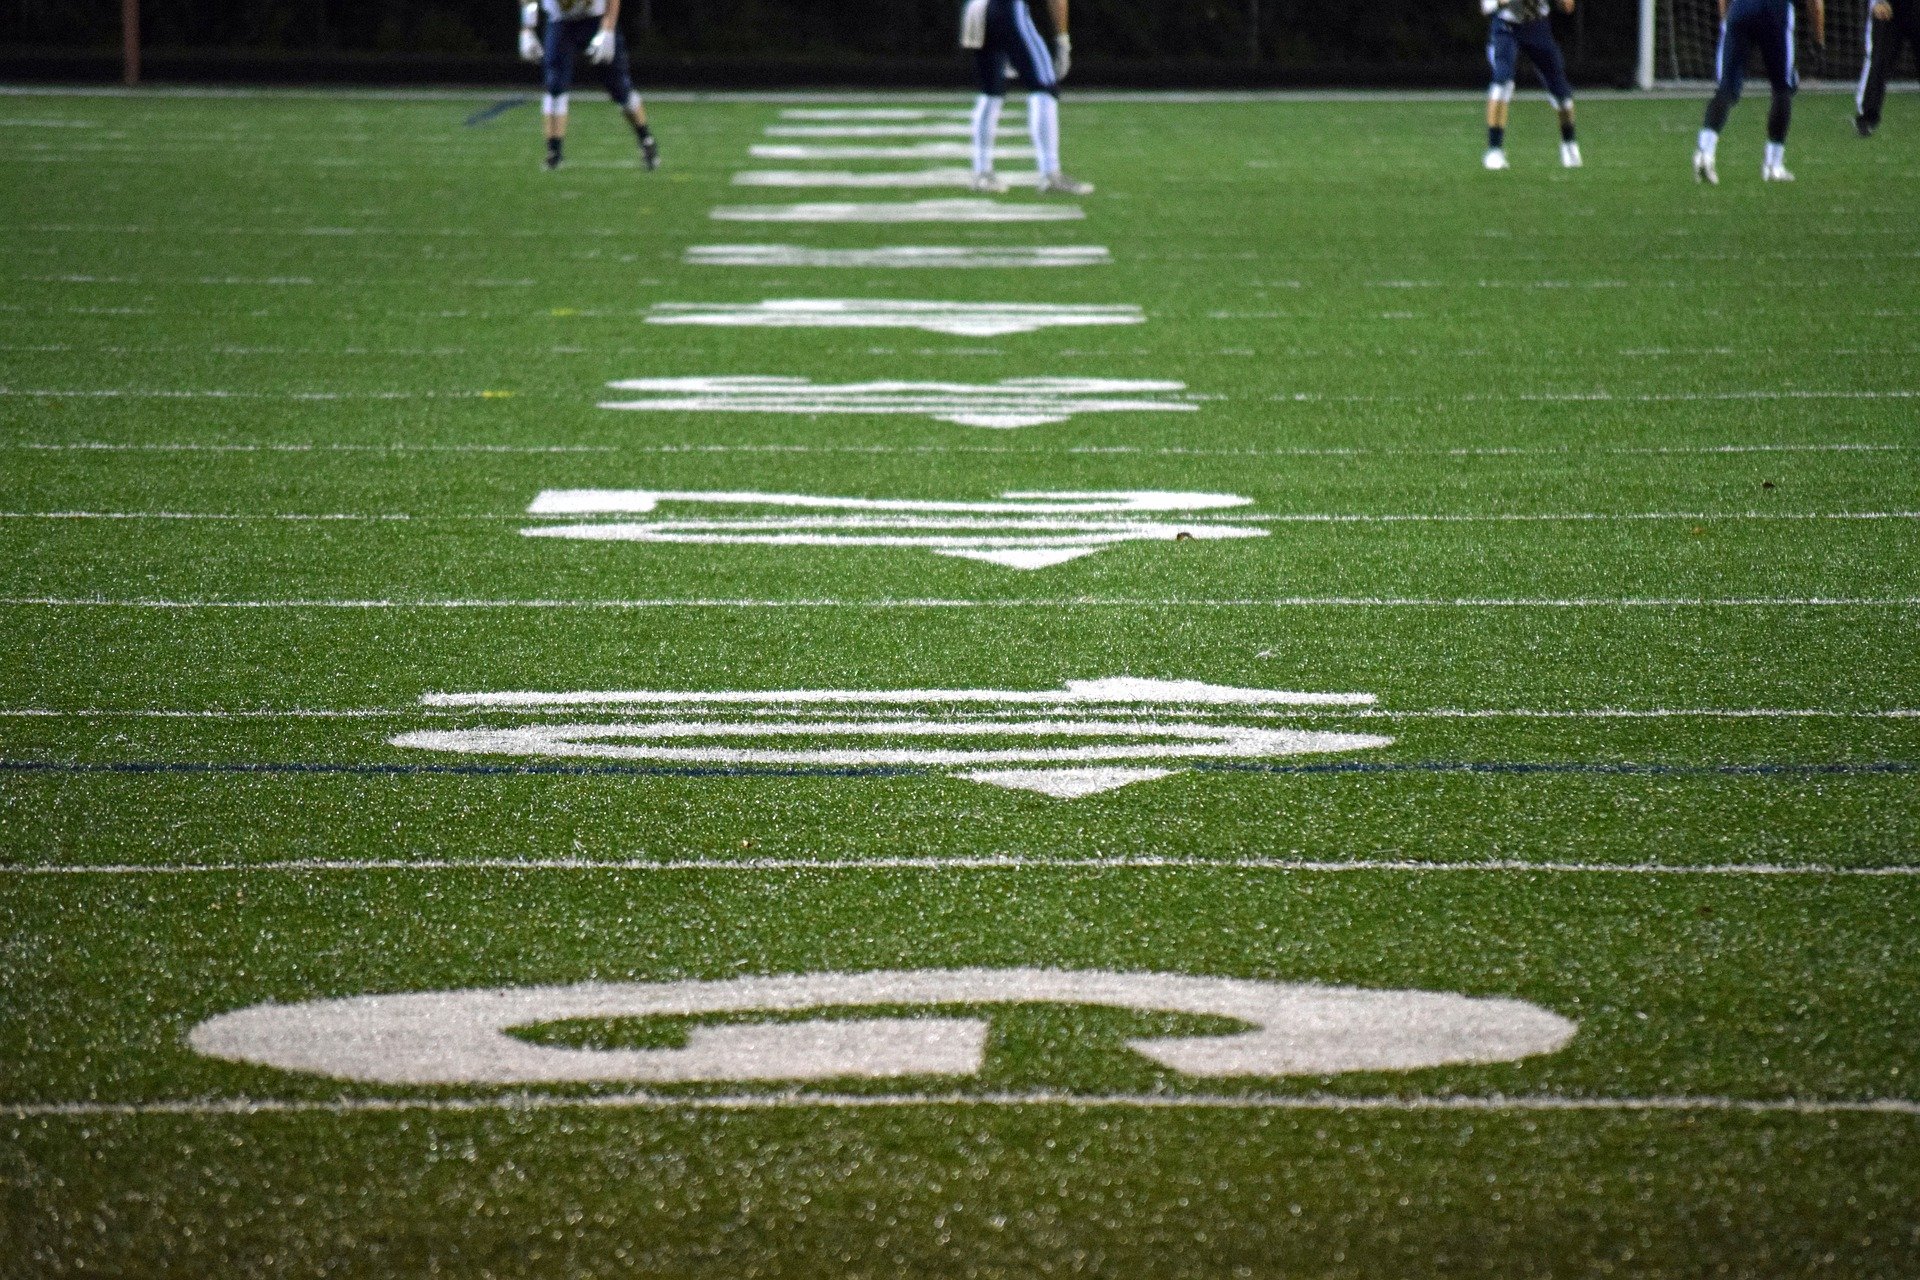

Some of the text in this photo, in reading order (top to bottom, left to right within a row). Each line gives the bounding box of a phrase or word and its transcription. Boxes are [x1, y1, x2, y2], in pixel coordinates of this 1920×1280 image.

[518, 488, 1272, 547] 20
[386, 676, 1396, 764] 10
[188, 967, 1579, 1085] G
